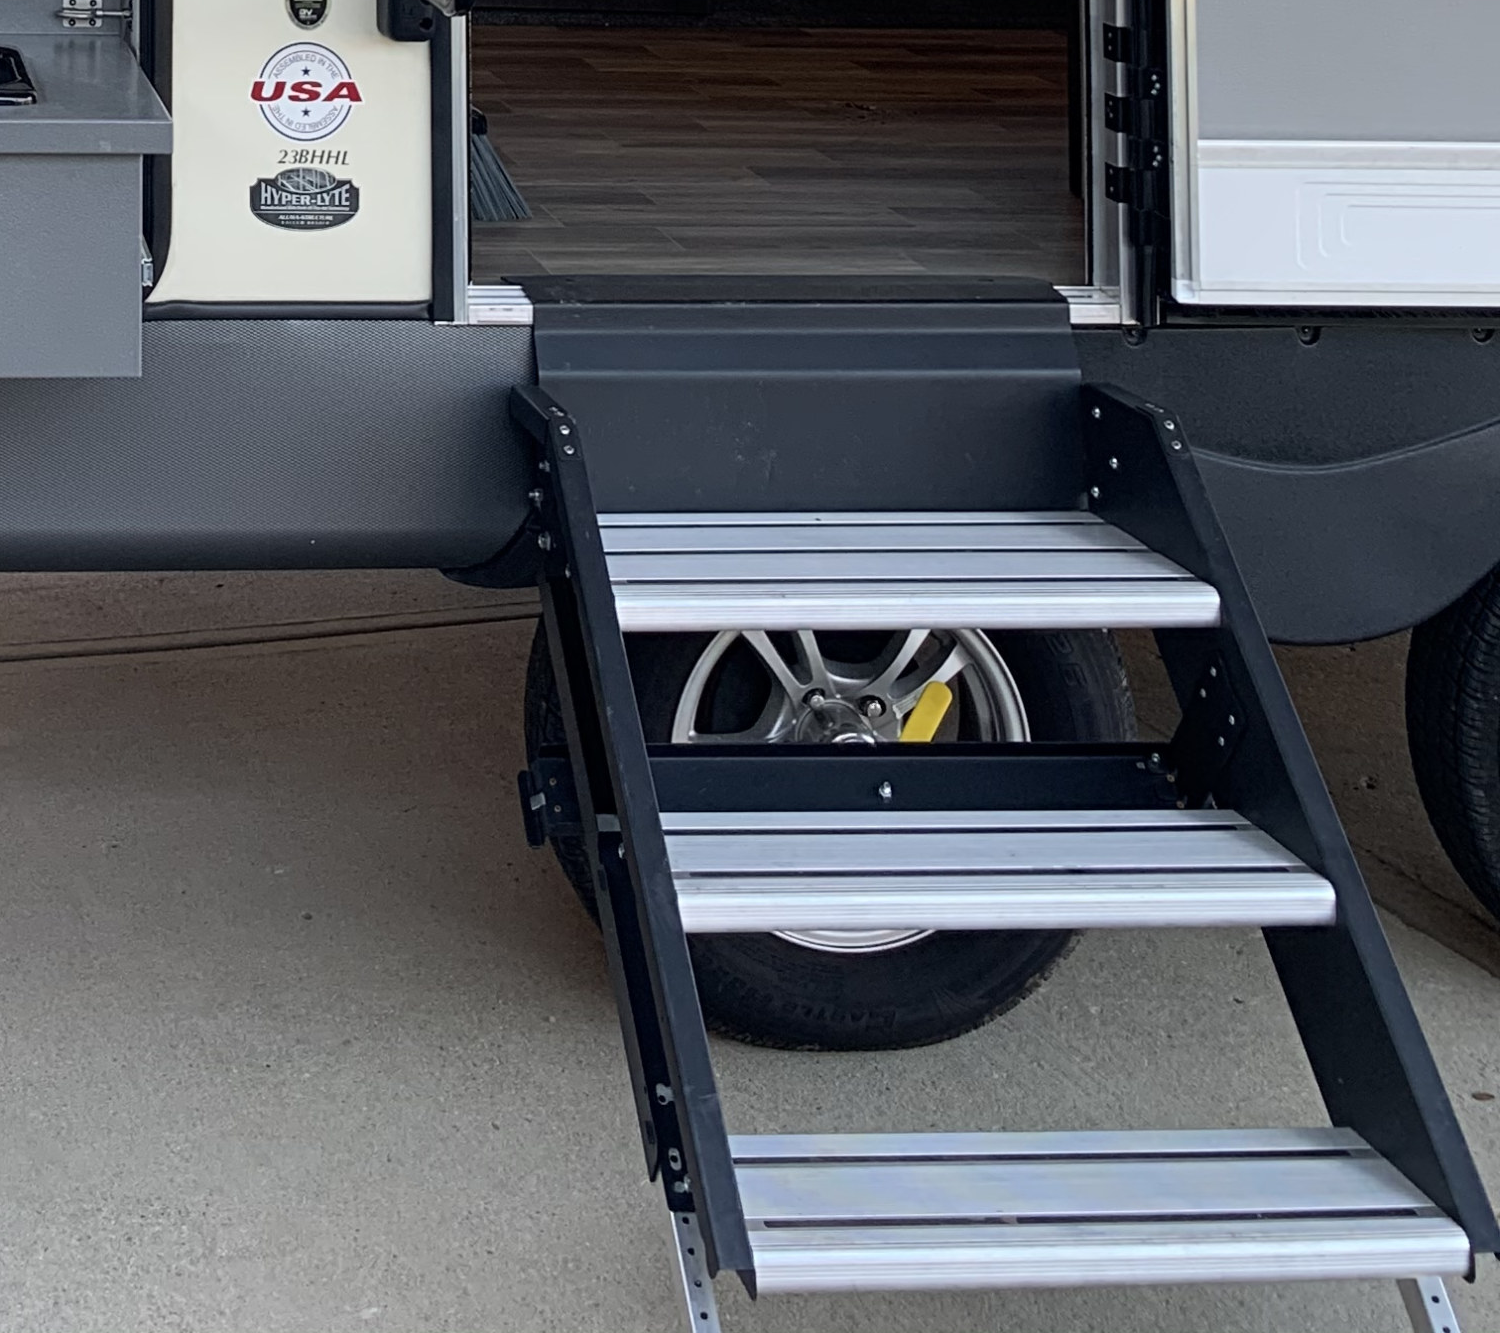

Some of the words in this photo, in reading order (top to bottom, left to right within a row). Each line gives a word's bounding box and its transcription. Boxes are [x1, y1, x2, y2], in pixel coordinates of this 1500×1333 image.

[273, 53, 317, 79] ASSEMBLED
[318, 55, 327, 67] IN
[325, 61, 339, 80] THE
[250, 81, 363, 102] USA
[272, 105, 286, 121] THE
[295, 106, 338, 131] ASSEMBLED
[277, 149, 350, 165] 23BHHL
[260, 181, 350, 206] HYPER-LYTE
